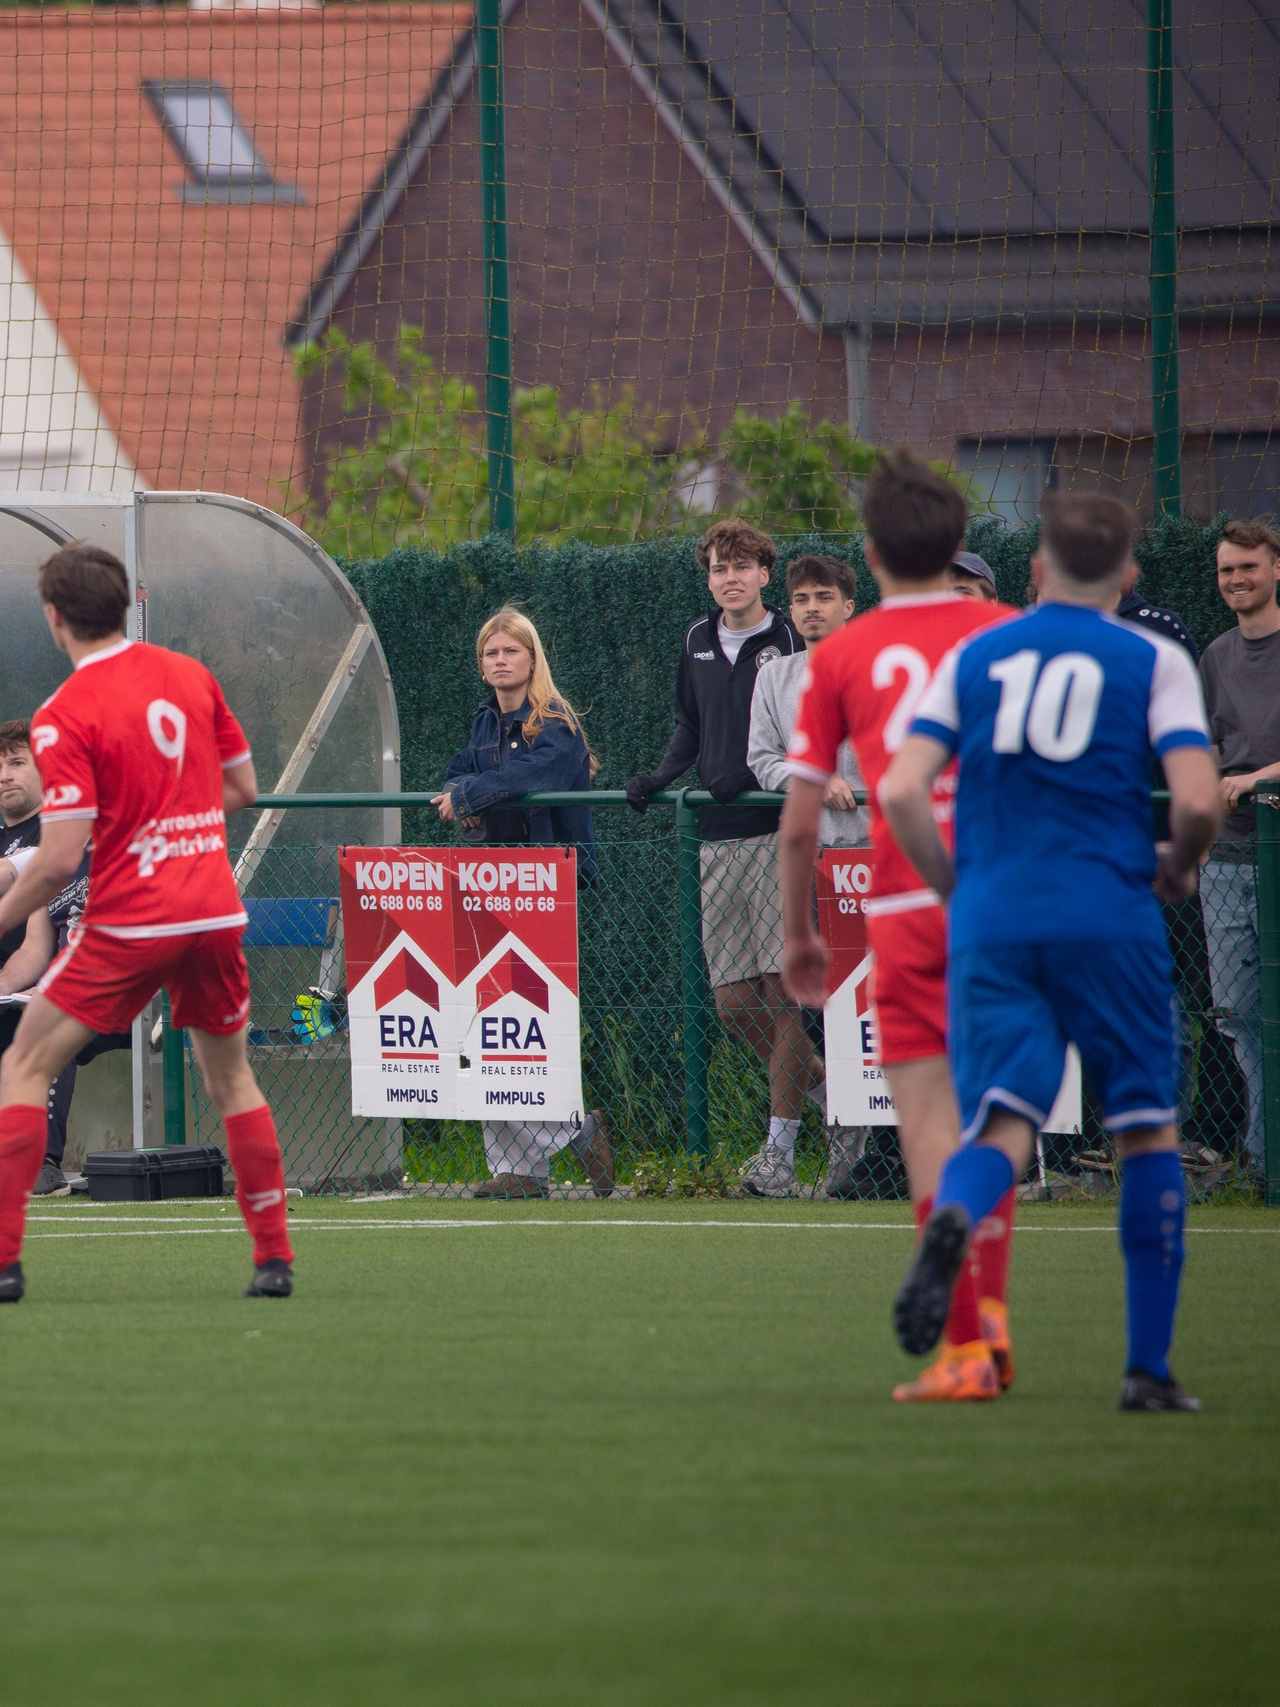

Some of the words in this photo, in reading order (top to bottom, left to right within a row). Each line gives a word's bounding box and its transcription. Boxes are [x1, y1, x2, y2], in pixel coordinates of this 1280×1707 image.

[871, 643, 931, 755] 2
[988, 648, 1105, 763] 10
[147, 698, 186, 777] 9
[355, 861, 444, 891] KOPEN
[458, 862, 558, 892] KOPEN
[360, 895, 377, 910] 02
[380, 895, 404, 911] 688
[406, 895, 423, 911] 06
[426, 896, 443, 911] 68
[463, 896, 482, 912] 02
[484, 896, 511, 912] 688
[514, 897, 533, 912] 06
[537, 897, 555, 912] 68
[838, 898, 858, 915] 02
[379, 1014, 439, 1048] ERA
[481, 1016, 547, 1050] ERA
[381, 1063, 405, 1073] REAL
[407, 1064, 440, 1074] ESTATE
[481, 1066, 506, 1075] REAL
[510, 1066, 548, 1076] ESTATE
[386, 1088, 438, 1104] IMMPULS
[485, 1090, 546, 1106] IMMPULS
